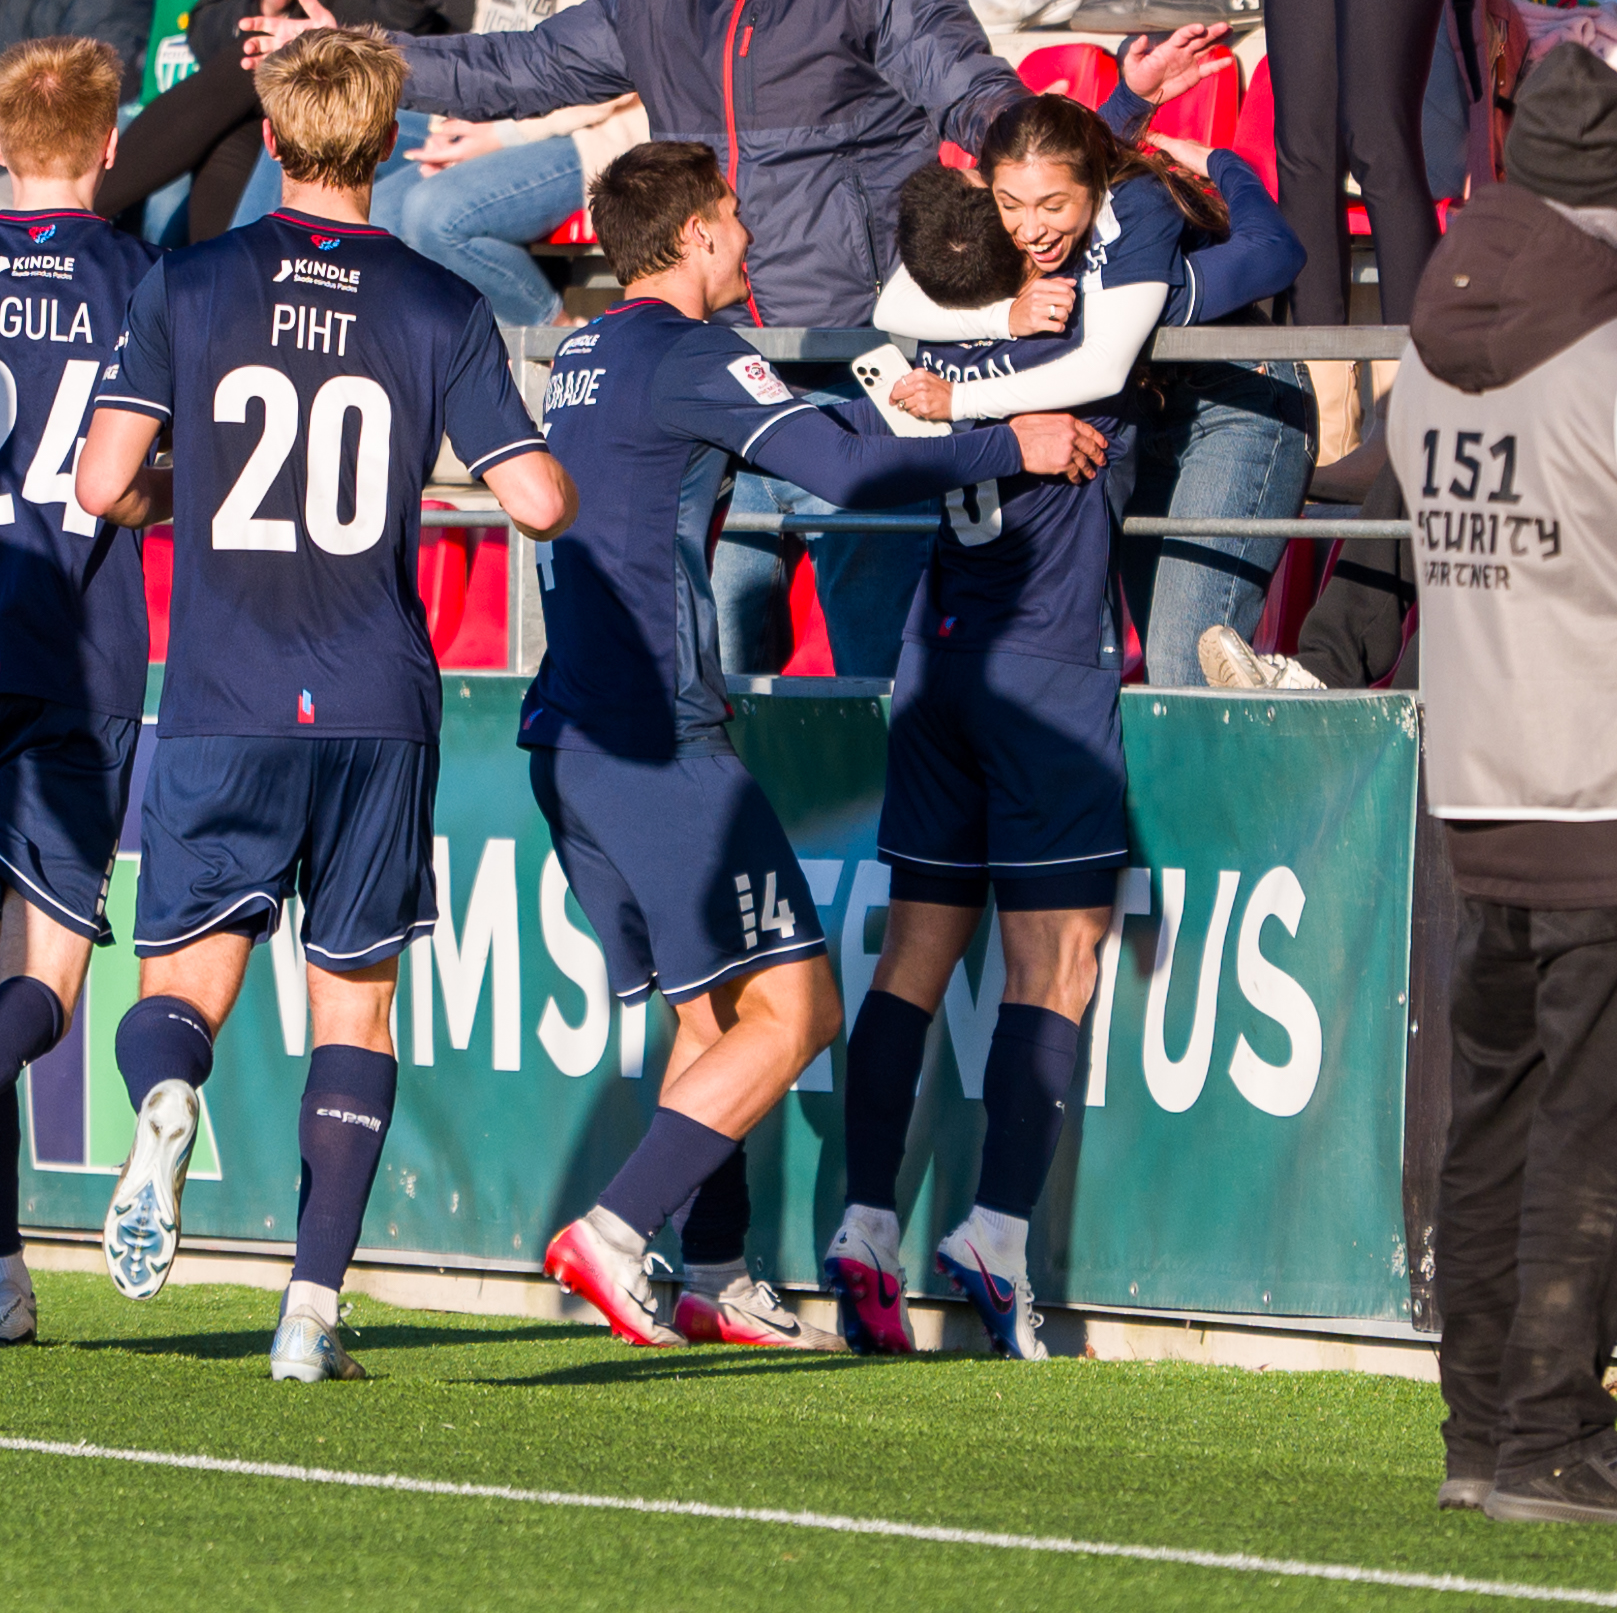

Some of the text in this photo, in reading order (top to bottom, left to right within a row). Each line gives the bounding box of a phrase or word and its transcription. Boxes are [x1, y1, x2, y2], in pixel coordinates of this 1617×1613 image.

[12, 255, 76, 272] KINDLE
[294, 258, 362, 285] KINDLE
[272, 303, 358, 357] PIHT
[211, 364, 393, 556] 20
[1421, 428, 1524, 506] 151
[1418, 510, 1564, 562] CURITY
